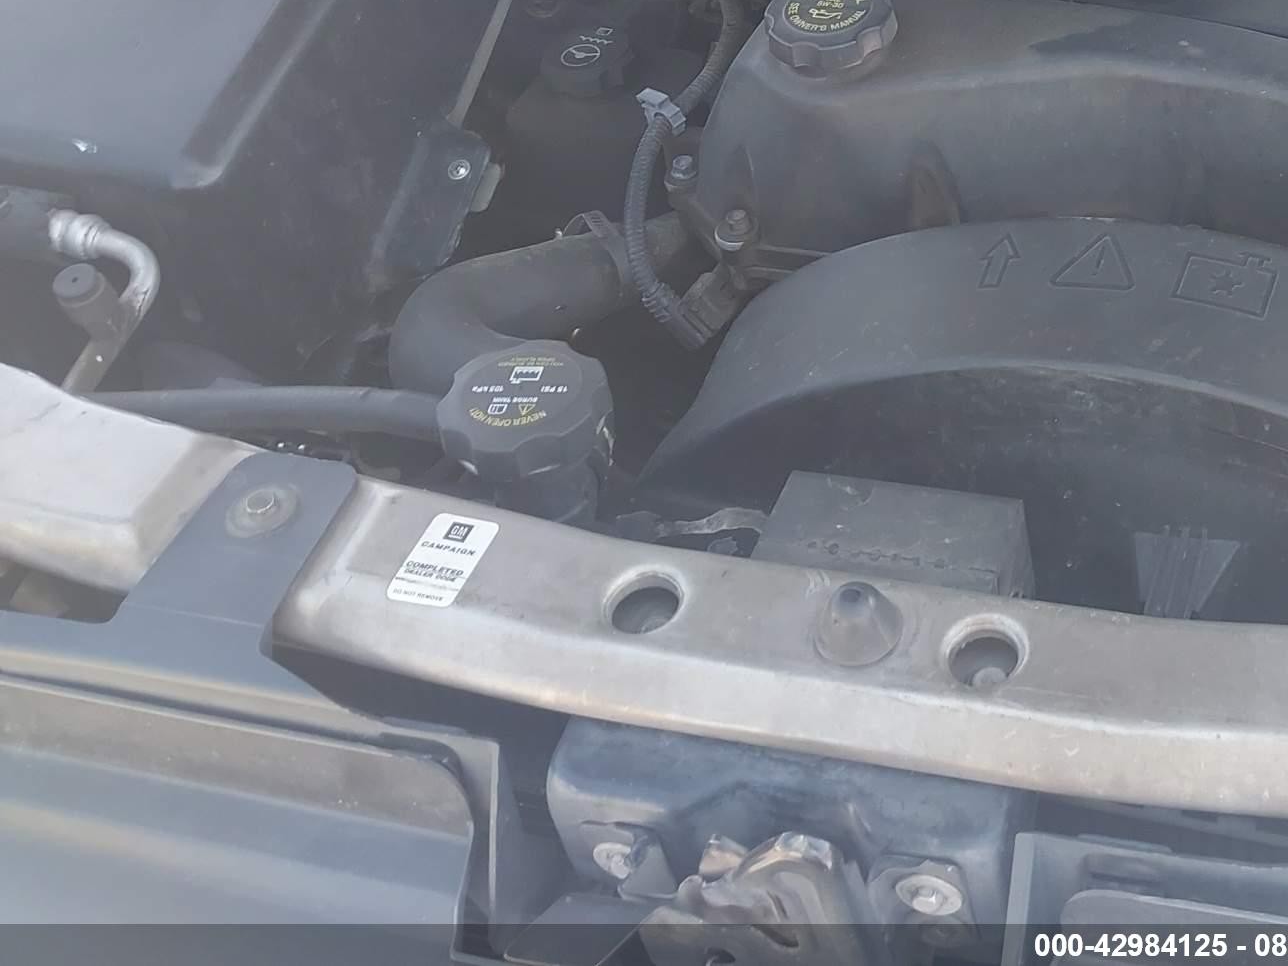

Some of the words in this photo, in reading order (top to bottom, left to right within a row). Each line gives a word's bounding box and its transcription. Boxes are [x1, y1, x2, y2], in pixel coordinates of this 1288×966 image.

[788, 2, 801, 15] SEE
[830, 9, 867, 31] MANUAL
[487, 417, 514, 427] OPEN
[513, 410, 547, 426] NEVER
[450, 525, 469, 537] GM
[421, 540, 477, 556] CAMPAIGN
[404, 568, 434, 579] DEALER
[406, 560, 464, 577] COMPLETED
[417, 592, 444, 602] REMOVE
